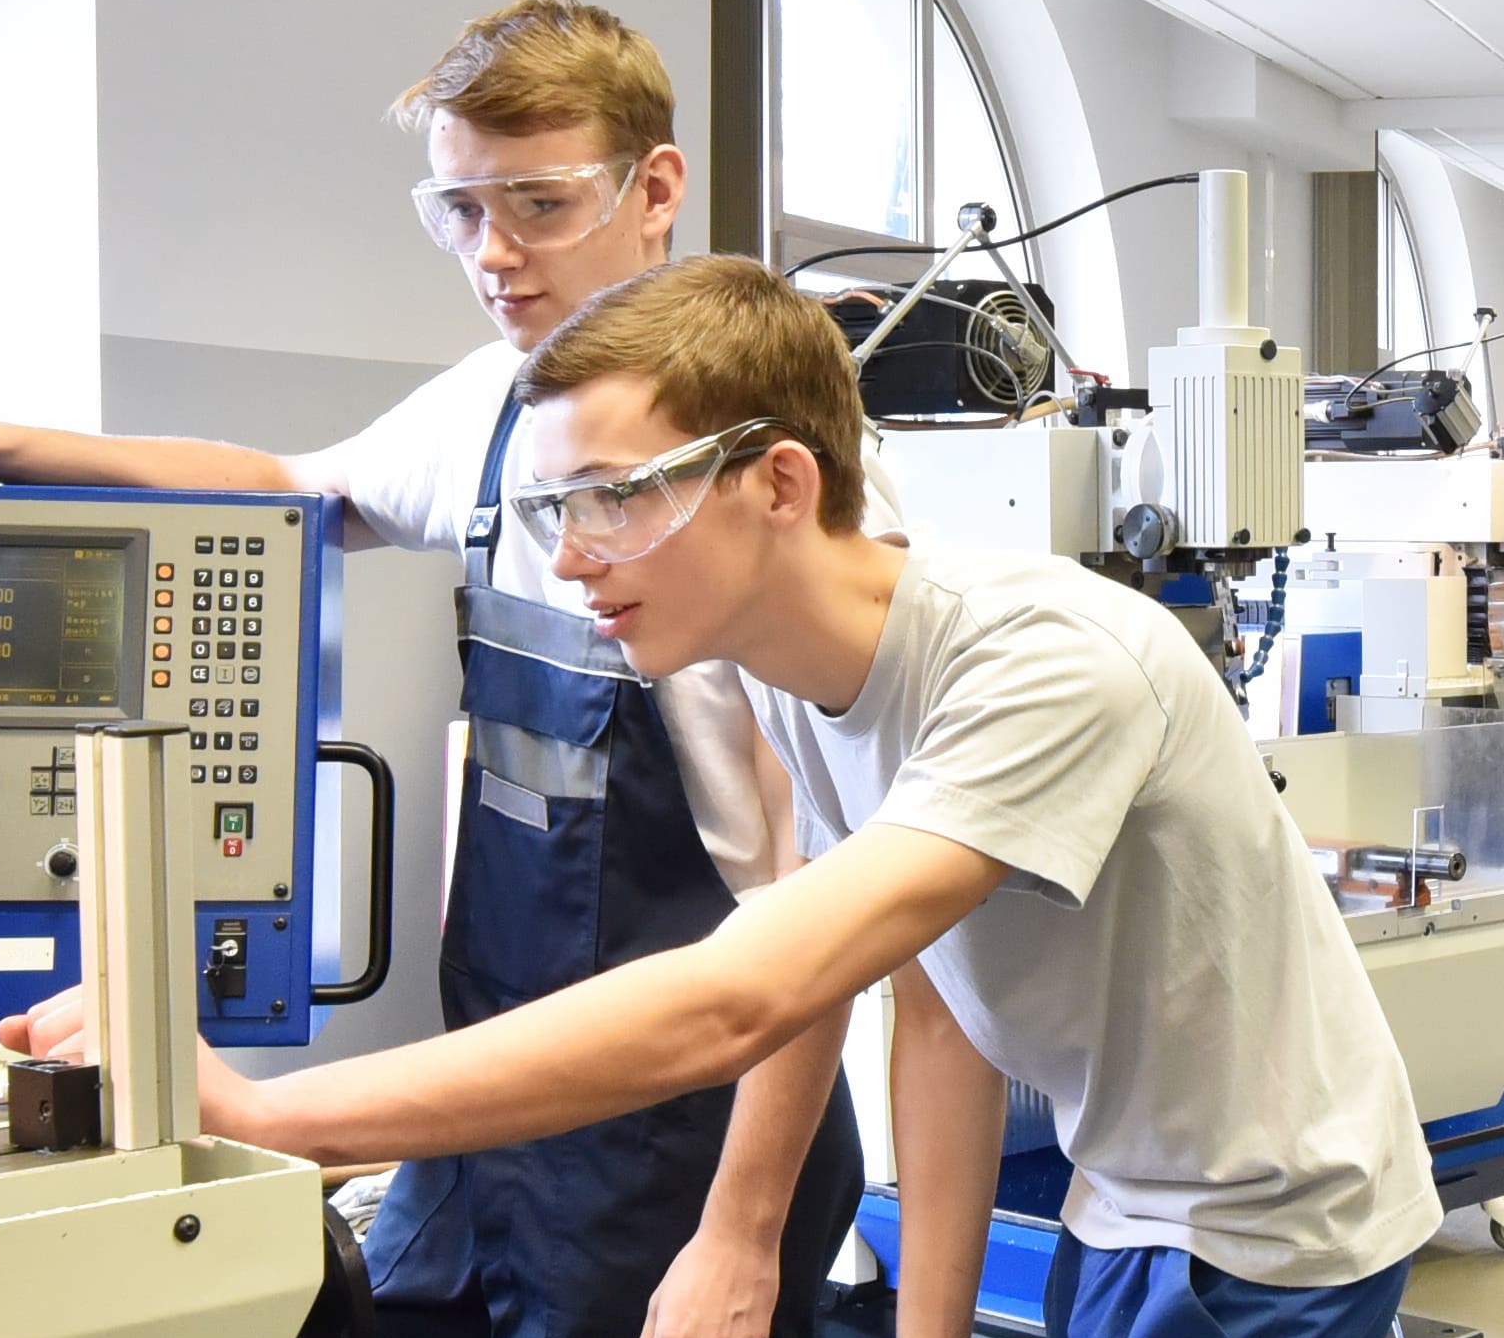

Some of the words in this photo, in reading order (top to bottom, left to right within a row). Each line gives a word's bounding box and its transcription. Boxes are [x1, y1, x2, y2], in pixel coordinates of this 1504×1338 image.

[198, 572, 208, 582] 7
[224, 573, 233, 583] 8
[249, 573, 258, 584] 9
[197, 596, 207, 607] 4
[223, 596, 232, 607] 5
[248, 597, 258, 608] 6
[198, 620, 205, 631] 1
[222, 621, 232, 632] 2
[248, 621, 257, 632] 3
[195, 644, 206, 655] 0
[192, 668, 207, 679] CE
